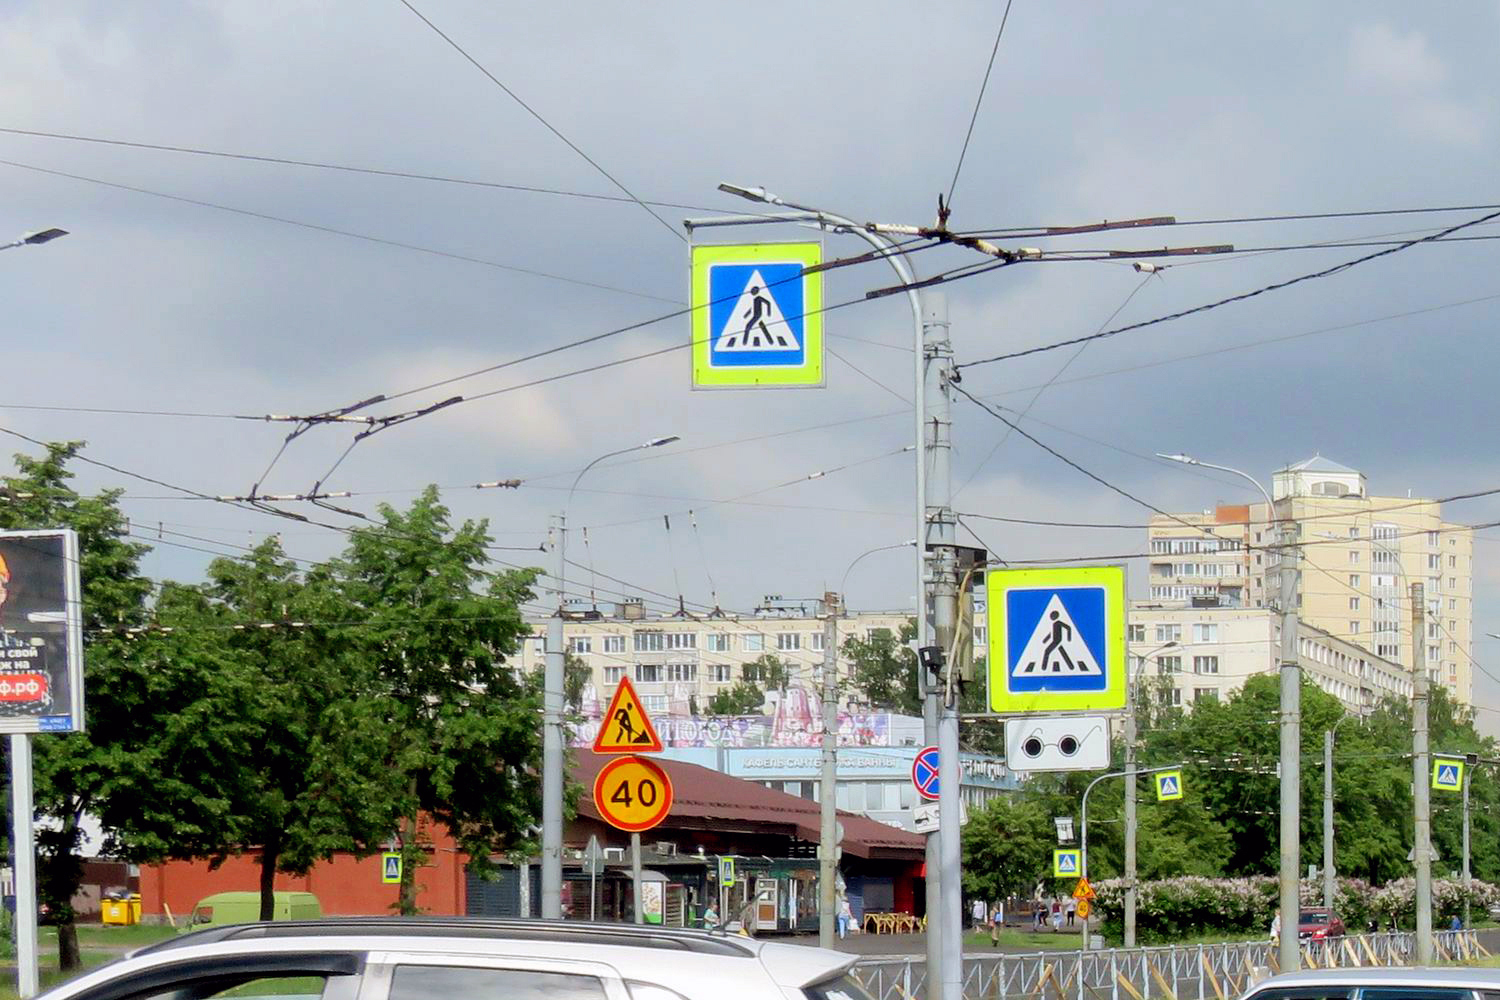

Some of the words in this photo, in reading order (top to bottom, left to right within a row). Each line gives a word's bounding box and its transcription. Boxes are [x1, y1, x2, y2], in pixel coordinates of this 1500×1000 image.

[8, 647, 38, 658] свой
[14, 661, 31, 670] на
[743, 758, 785, 769] КАФЕЛЬ
[859, 757, 897, 769] ВАННЫ
[610, 779, 657, 808] 40
